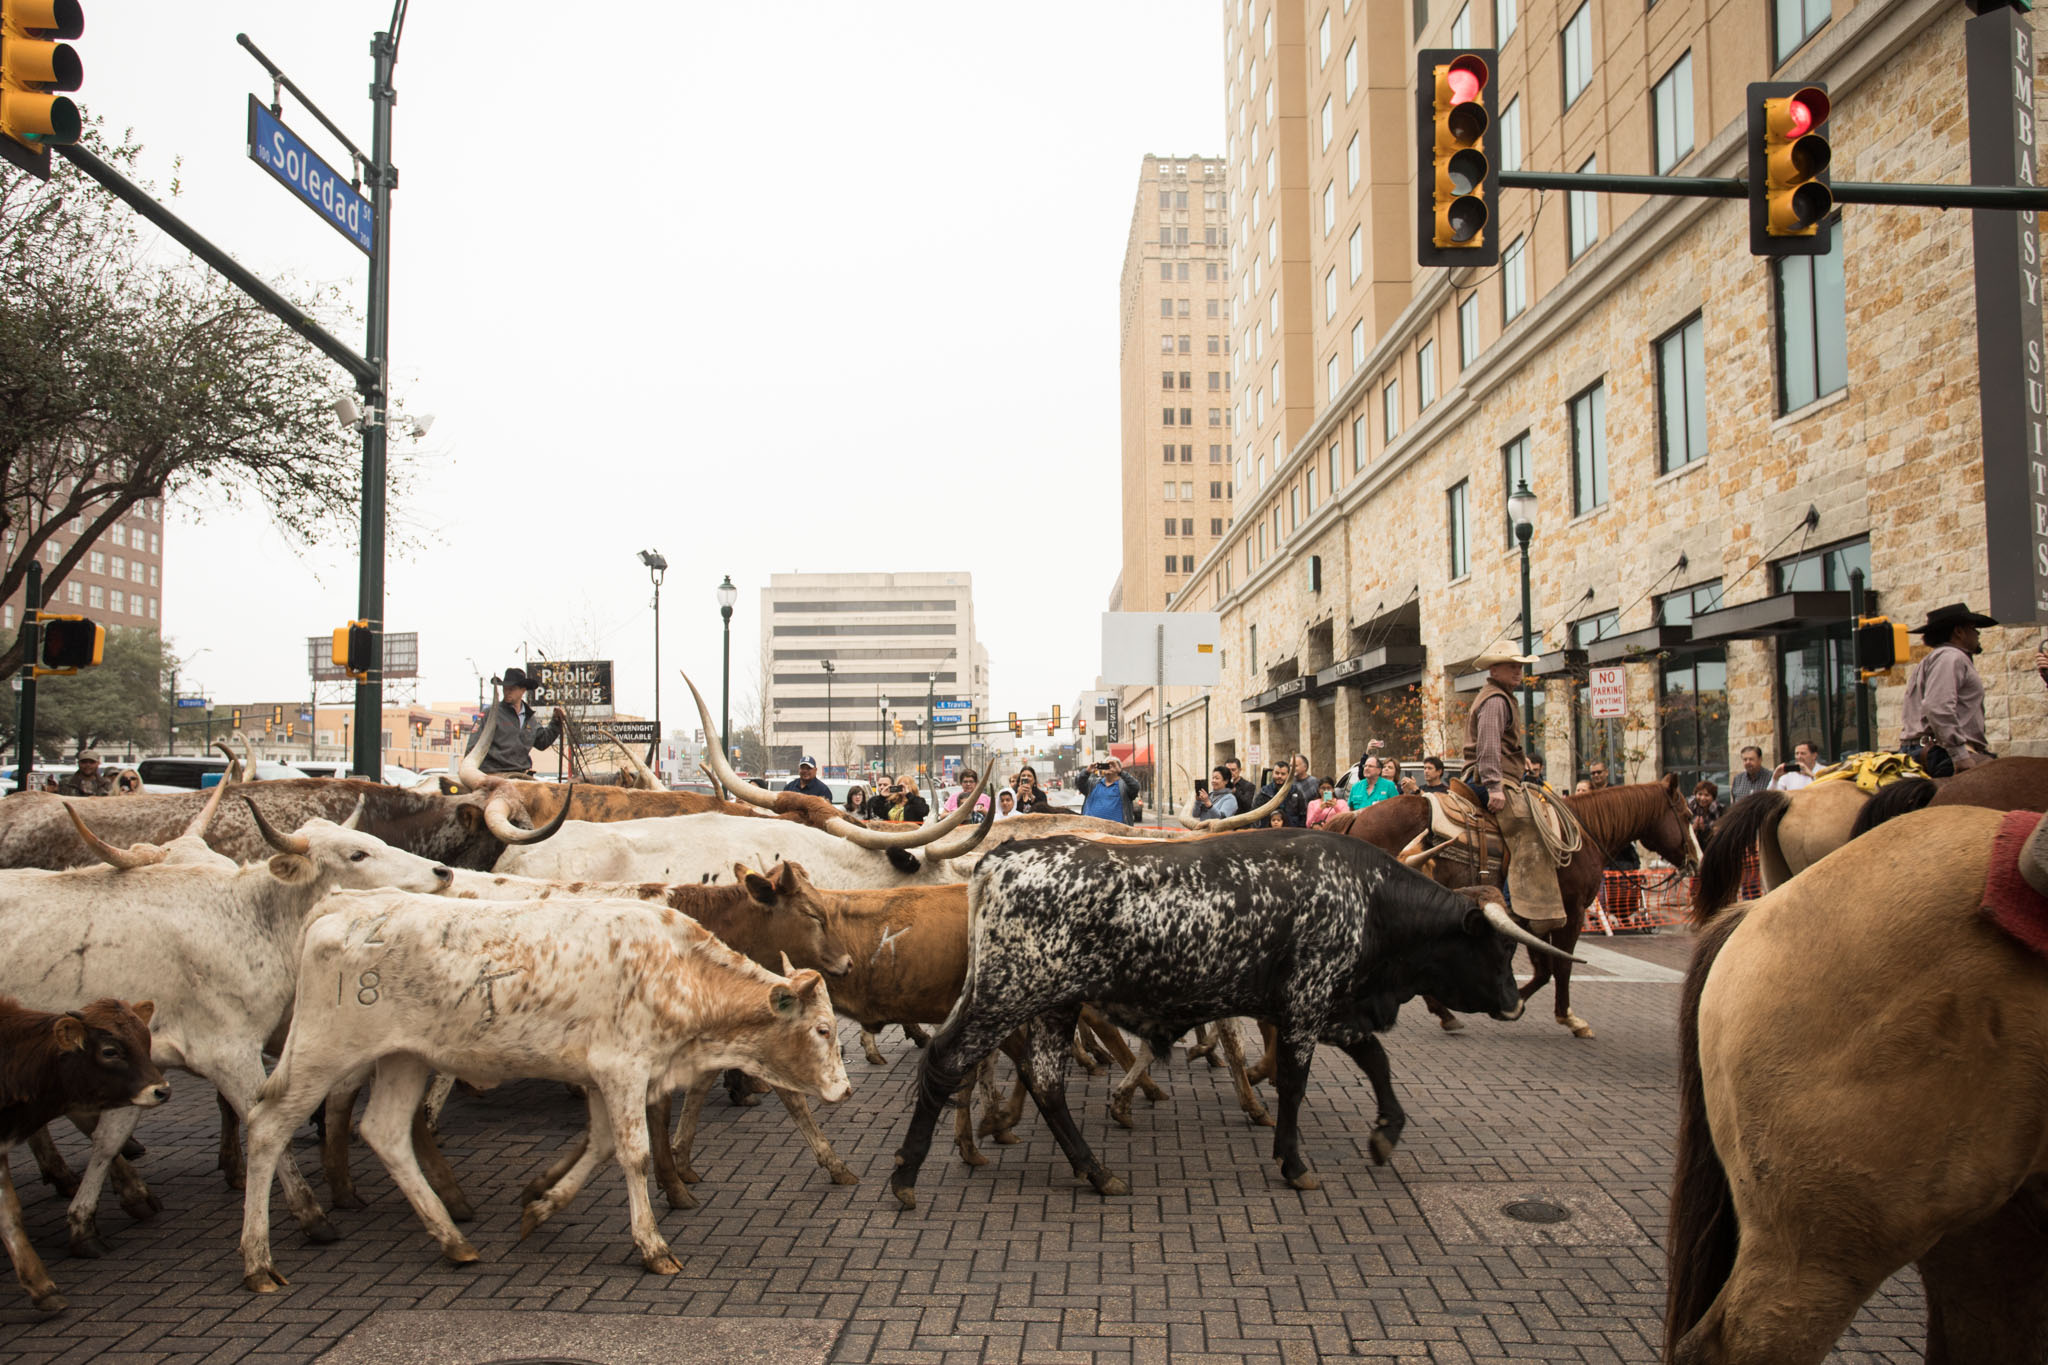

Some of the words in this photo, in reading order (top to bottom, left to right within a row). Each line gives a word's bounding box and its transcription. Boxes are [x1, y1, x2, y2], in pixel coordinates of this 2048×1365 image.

[273, 131, 359, 235] Soledad
[363, 204, 371, 222] St
[359, 231, 370, 249] 200
[2028, 339, 2048, 577] SUITES
[541, 667, 597, 684] Public
[1600, 671, 1615, 684] NO
[535, 684, 602, 703] Parking
[1593, 685, 1623, 696] PARKING
[1595, 697, 1622, 705] ANYTIME
[613, 724, 654, 732] OVERNIGHT
[1109, 700, 1117, 741] WESTON
[616, 733, 652, 741] AVAILABLE
